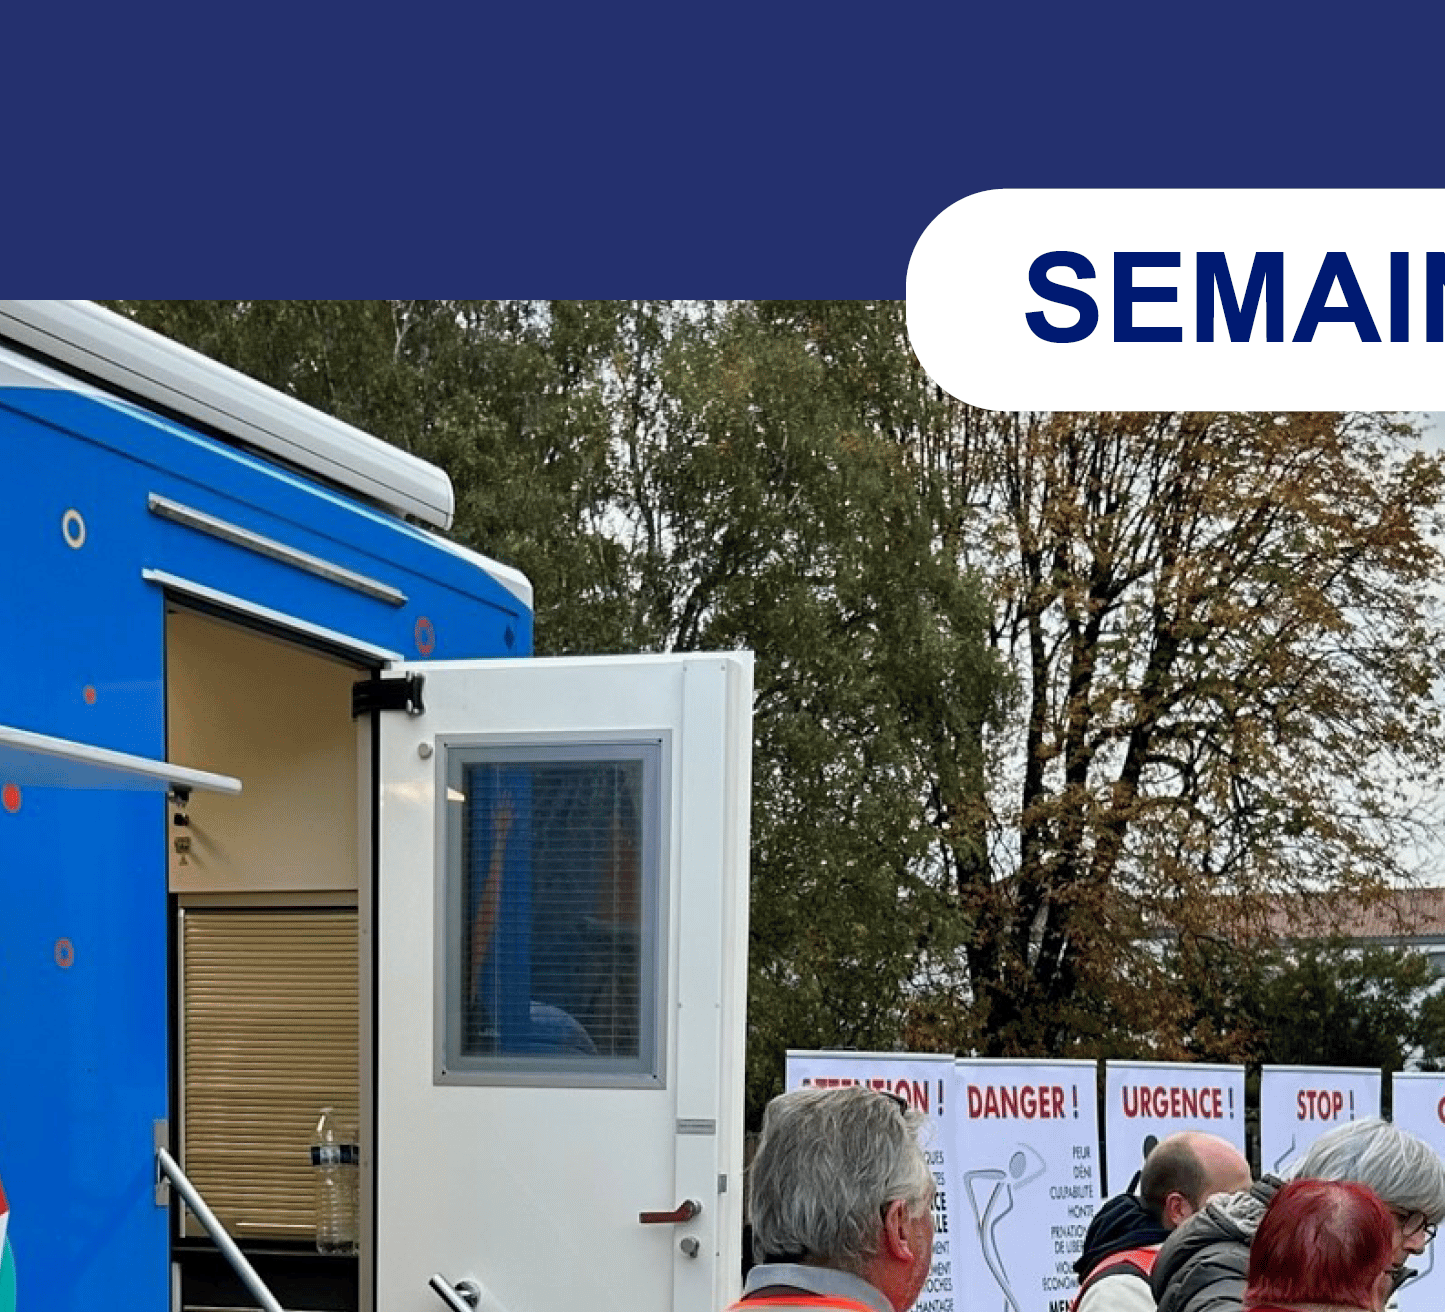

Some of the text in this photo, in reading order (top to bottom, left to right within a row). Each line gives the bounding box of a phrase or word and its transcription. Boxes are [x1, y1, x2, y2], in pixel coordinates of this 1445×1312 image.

[967, 1085, 1066, 1119] DANGER
[1122, 1085, 1223, 1119] URGENCE
[1297, 1089, 1343, 1121] STOP
